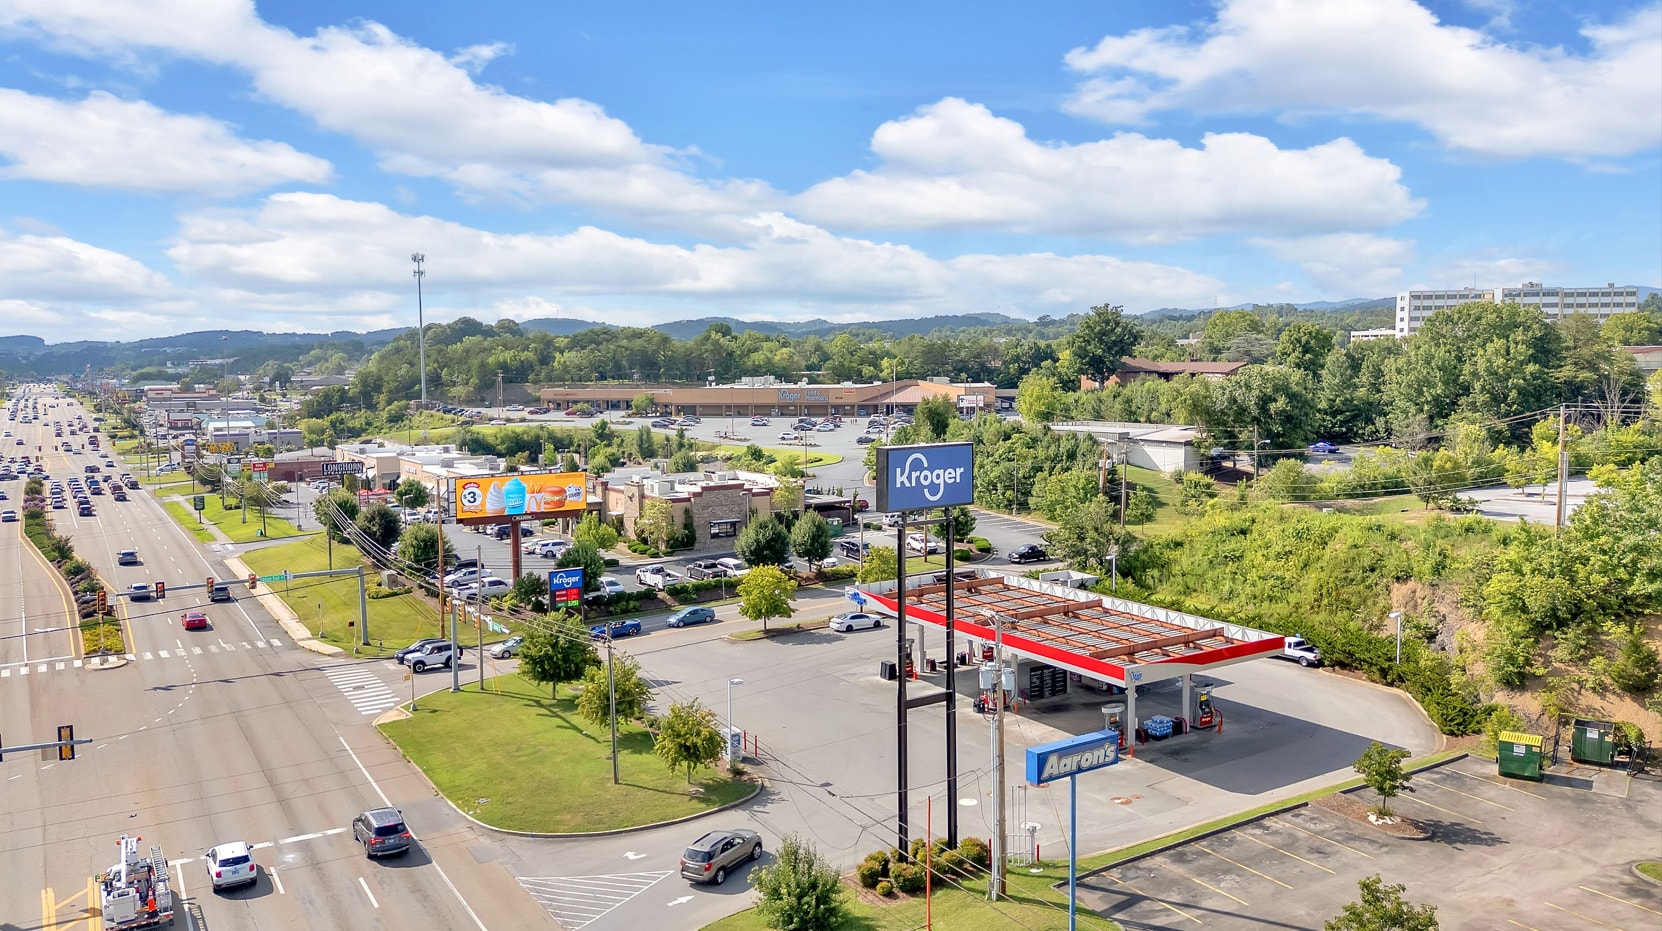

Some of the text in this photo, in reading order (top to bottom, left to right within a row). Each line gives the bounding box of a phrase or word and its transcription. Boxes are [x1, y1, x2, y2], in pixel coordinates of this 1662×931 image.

[778, 389, 800, 402] Kroger
[323, 462, 362, 472] LONGHORN
[895, 453, 965, 502] Kroger
[553, 573, 580, 588] Kroger
[1041, 743, 1117, 780] Aaron's
